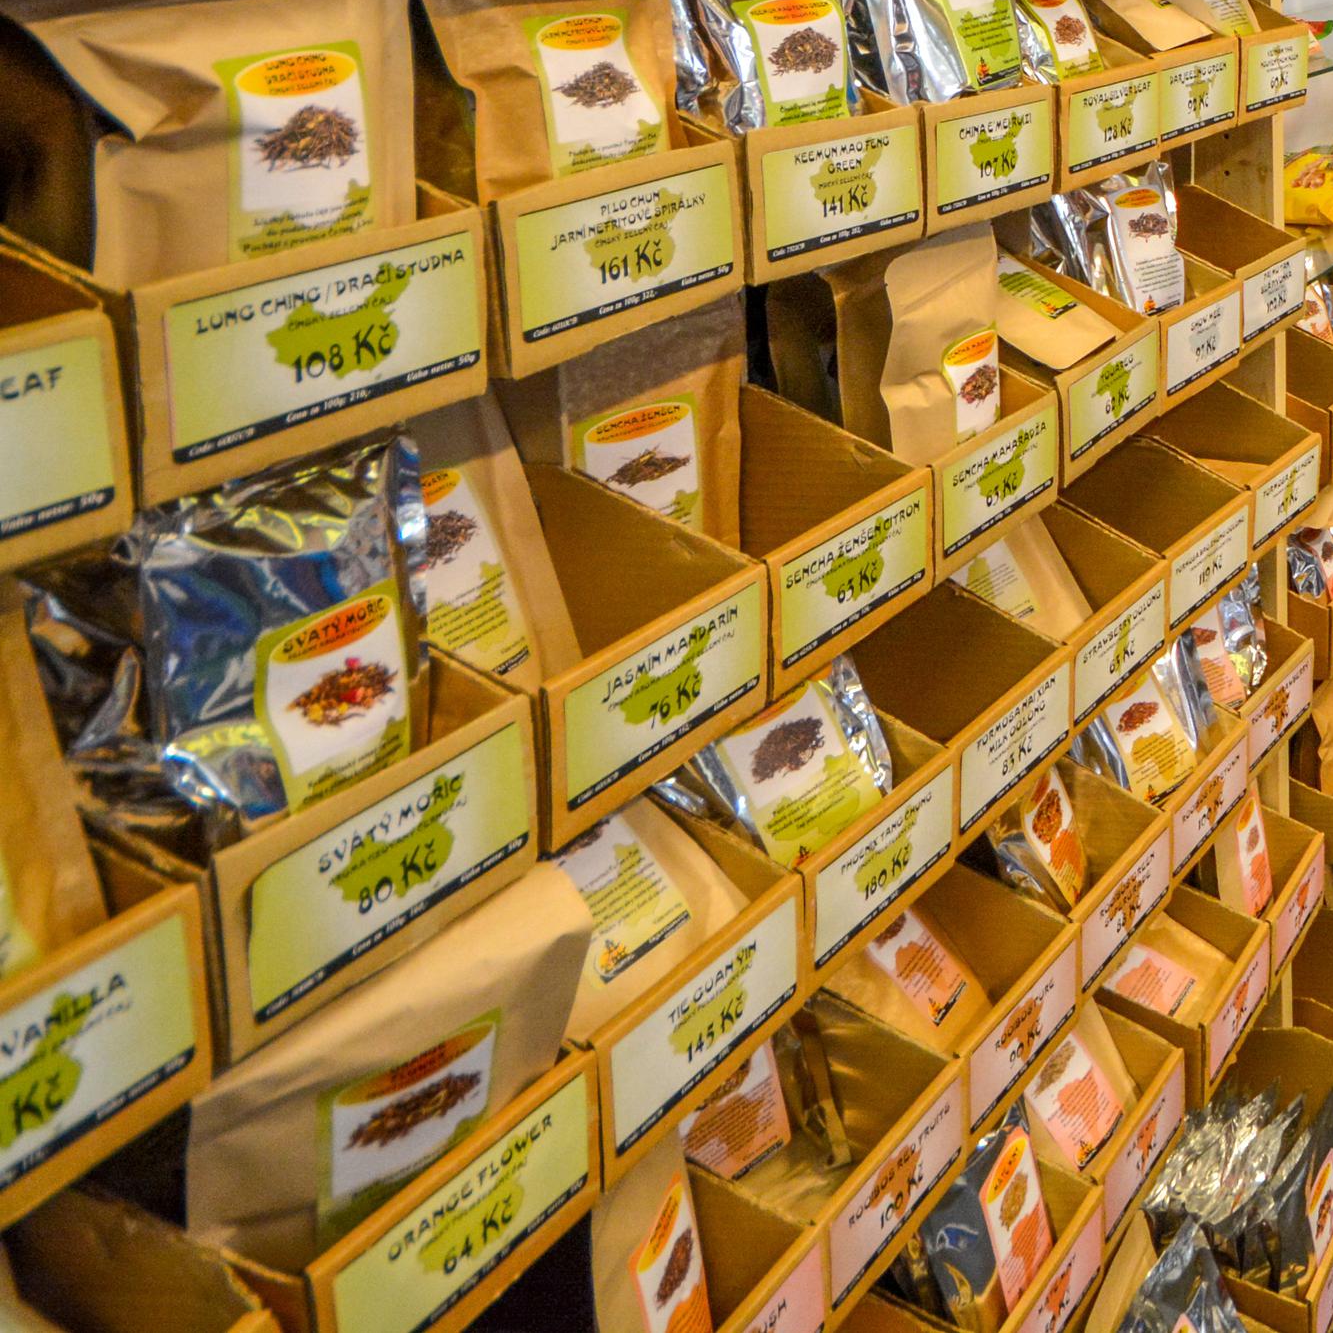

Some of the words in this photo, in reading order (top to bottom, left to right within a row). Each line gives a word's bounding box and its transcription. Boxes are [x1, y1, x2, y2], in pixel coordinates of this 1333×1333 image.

[1082, 91, 1109, 108] ROYAL
[1133, 80, 1152, 97] LEAF
[794, 146, 838, 165] KEEMUN
[840, 141, 864, 158] MAO
[864, 135, 890, 151] FENG
[959, 123, 987, 140] CHINA
[1118, 116, 1133, 138] Kč
[827, 158, 862, 174] GREEN
[979, 158, 998, 178] 107
[1000, 149, 1018, 173] Kč
[550, 223, 587, 251] JARNÍ
[588, 208, 652, 235] NEFRITOVÉ
[654, 192, 707, 218] SPIRÁLKY
[612, 199, 627, 213] LO
[629, 189, 661, 209] CHUN
[821, 196, 844, 218] 141
[848, 184, 869, 210] Kč
[599, 254, 629, 284] 161
[634, 239, 663, 274] Kč
[195, 305, 255, 336] LUNG
[260, 283, 321, 317] CHING
[335, 267, 392, 297] DRAČÍ
[395, 248, 466, 280] STUDNA
[291, 343, 345, 383] 108
[352, 322, 393, 366] Kč
[952, 456, 990, 487] SENCHA
[991, 421, 1048, 460] MAHARADŽA
[1001, 471, 1019, 497] Kč
[785, 549, 834, 590] SENCHA
[837, 519, 882, 559] ŽENŠEN
[882, 499, 922, 532] CITRON
[857, 561, 879, 594] Kč
[280, 610, 343, 656] SVATÝ
[343, 596, 386, 629] MOŘIC
[601, 651, 661, 704] JASMÍN
[664, 604, 738, 662] MANDARÍN
[649, 695, 671, 729] 76
[676, 673, 701, 710] Kč
[988, 733, 1009, 756] MILK
[1009, 700, 1047, 739] OOLONG
[1017, 735, 1034, 763] Kč
[316, 811, 392, 875] SVATÝ
[396, 770, 467, 833] MOŘIC
[840, 837, 878, 875] PHOENIX
[877, 817, 904, 844] TANG
[904, 790, 933, 821] CHUNG
[356, 879, 394, 917] 80
[400, 842, 439, 898] Kč
[863, 868, 888, 902] 180
[891, 845, 911, 875] Kč
[667, 999, 690, 1026] TIE
[692, 962, 734, 1005] GUAN
[736, 940, 757, 964] YIN
[720, 993, 745, 1034] Kč
[13, 1070, 64, 1135] Kč
[387, 1177, 474, 1263] ORANGE
[477, 1113, 554, 1188] FLOWER
[848, 1168, 896, 1228] ROOIBOS
[917, 1103, 951, 1145] FRUITS
[879, 1190, 904, 1229] 100
[906, 1161, 924, 1192] Kč
[443, 1234, 474, 1276] 64
[481, 1194, 514, 1244] Kč
